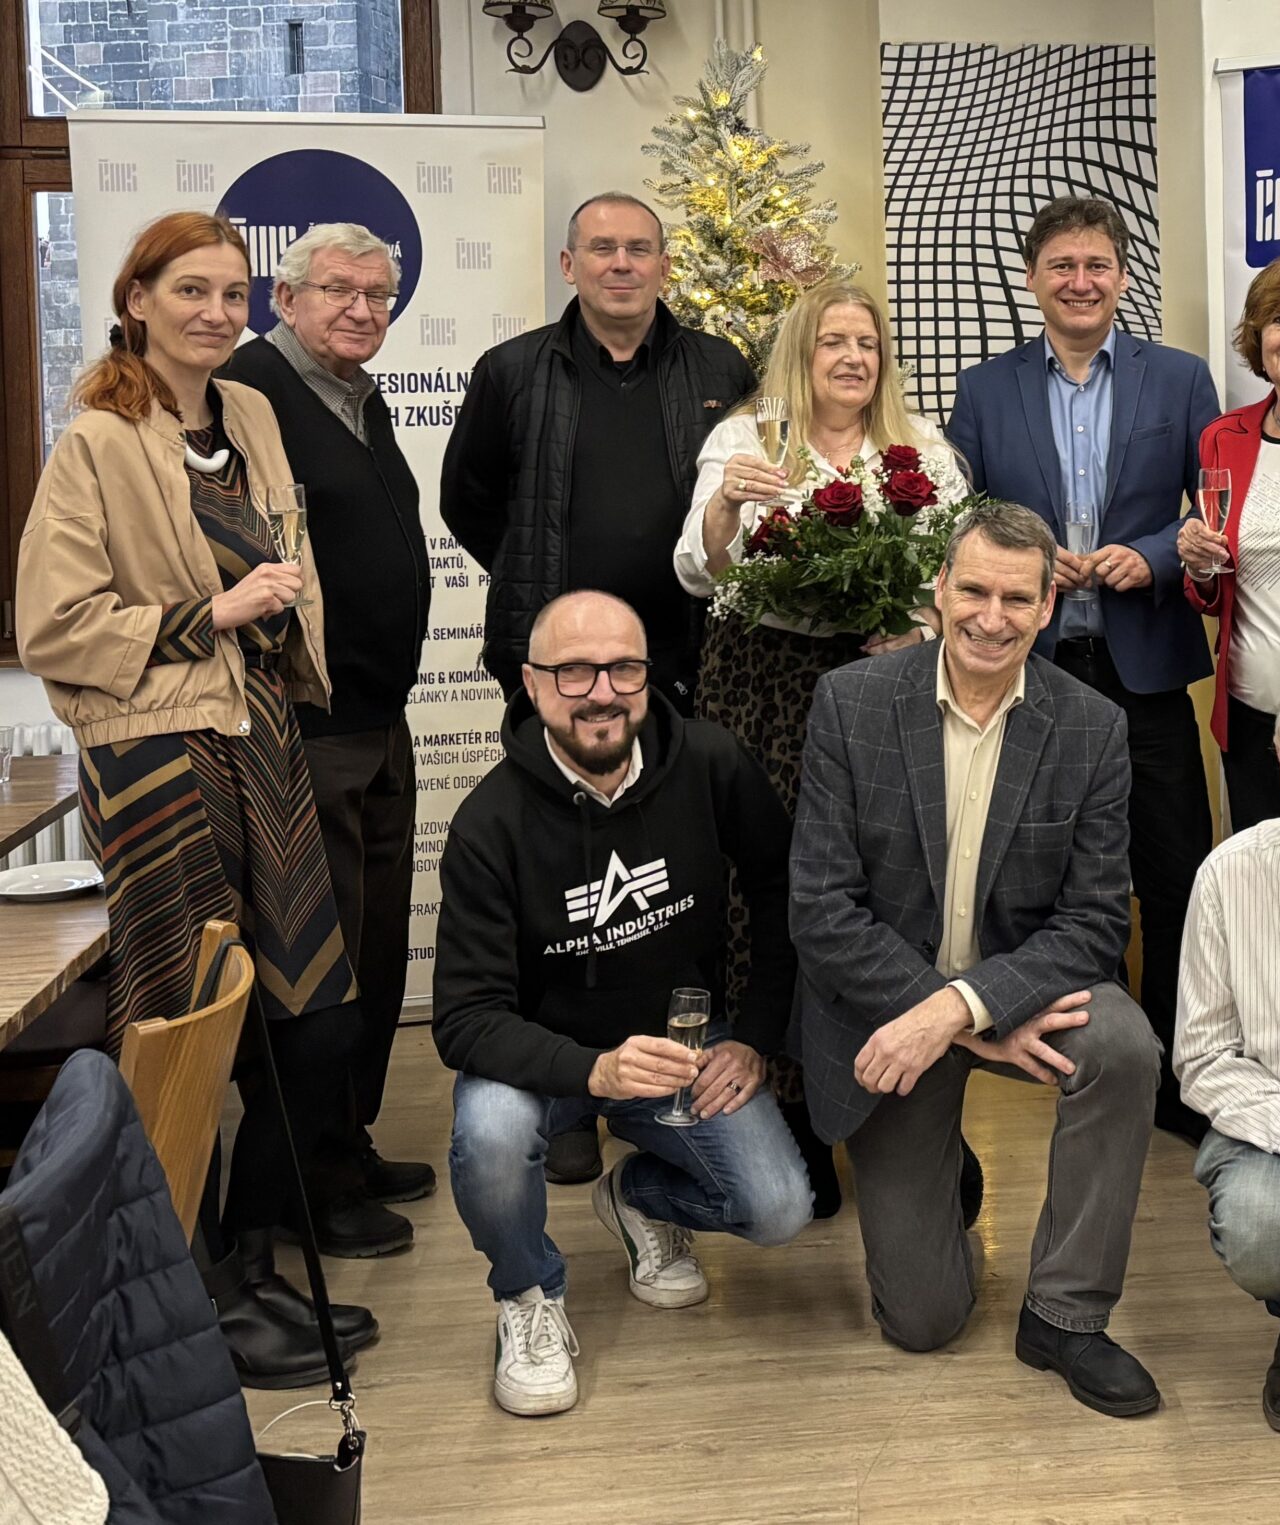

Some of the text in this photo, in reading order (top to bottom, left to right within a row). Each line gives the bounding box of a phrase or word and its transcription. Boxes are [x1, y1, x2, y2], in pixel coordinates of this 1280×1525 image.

[369, 366, 475, 394] ESIONÁLN
[429, 553, 467, 570] TAKTŮ,
[445, 572, 469, 588] VAŠI
[433, 623, 484, 641] SEMINÁŘ
[451, 689, 458, 702] A
[461, 686, 502, 701] NOVINK
[423, 729, 482, 747] MARKETÉR
[485, 730, 500, 743] RO
[420, 750, 459, 766] VAŠICH
[462, 747, 505, 763] ÚSPĚCH
[415, 775, 484, 791] AVENÉ ODBO
[414, 821, 450, 835] LIZOVA
[415, 840, 447, 854] MINO
[409, 902, 443, 917] PRAK
[606, 894, 695, 942] INDUSTRIES
[407, 947, 435, 961] STUD
